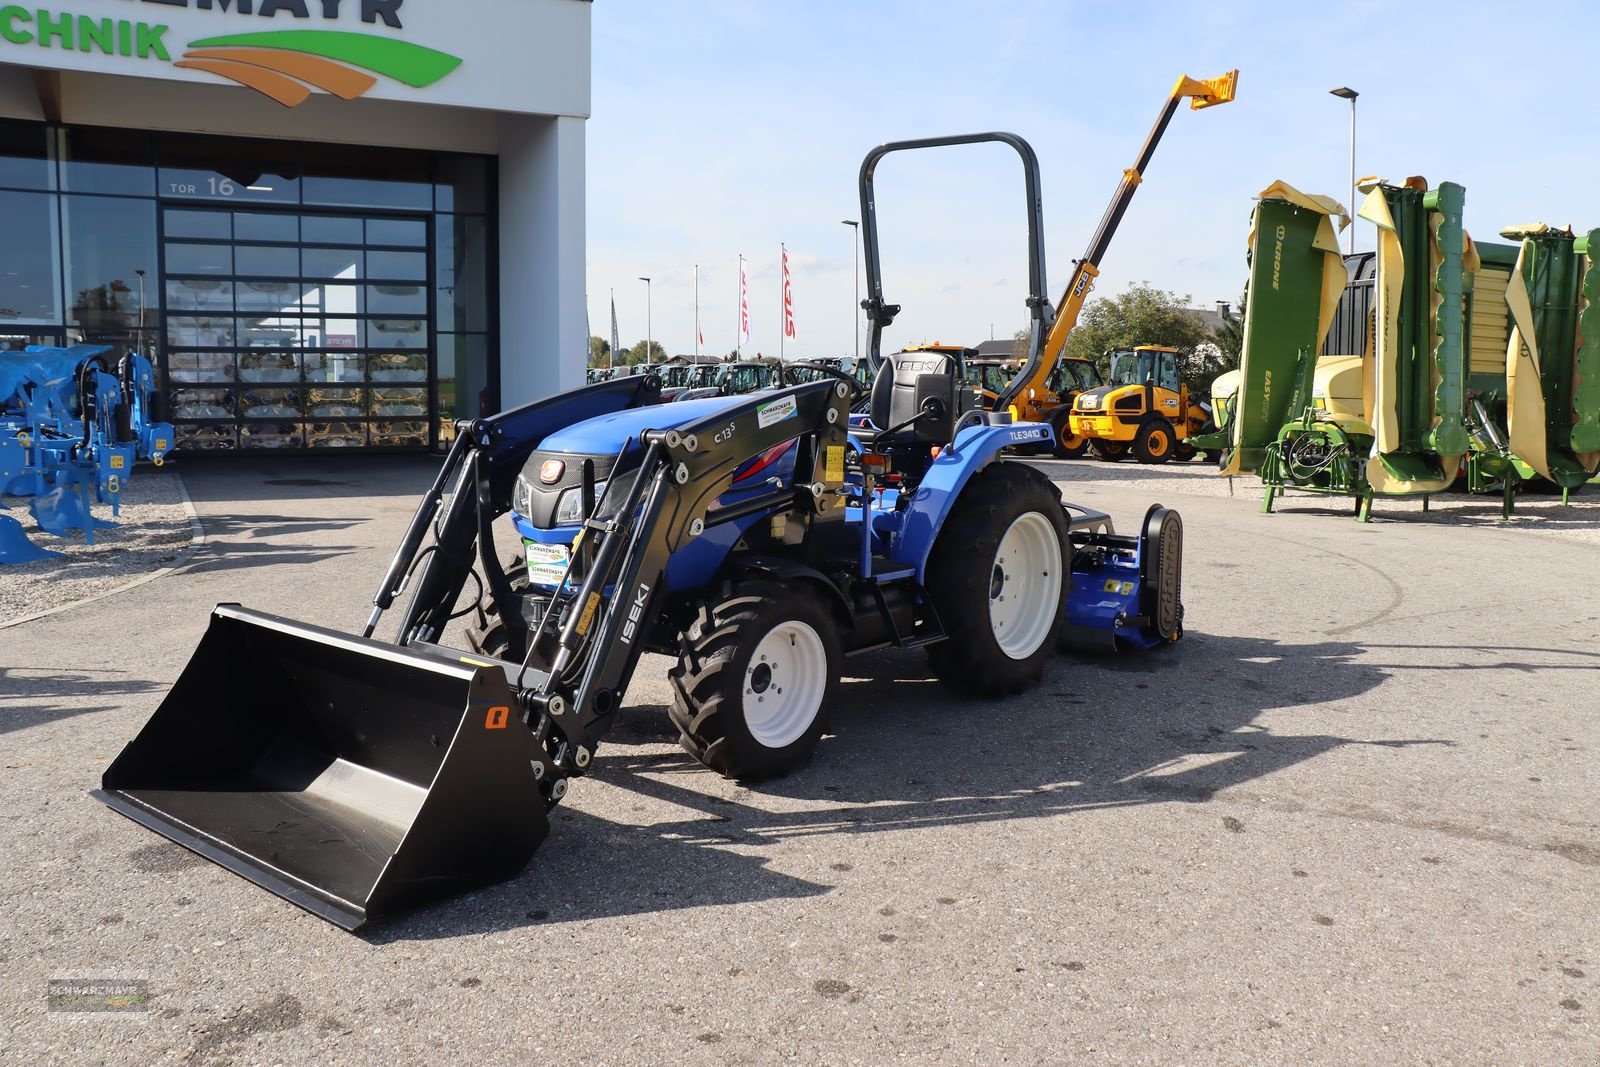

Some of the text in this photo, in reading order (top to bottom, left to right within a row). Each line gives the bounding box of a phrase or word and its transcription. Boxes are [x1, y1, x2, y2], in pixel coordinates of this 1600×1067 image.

[170, 177, 234, 196] TOR 16
[1272, 241, 1285, 290] KRONE
[1075, 271, 1090, 297] JCB
[896, 360, 937, 372] ISEKI
[620, 582, 650, 644] ISEKI
